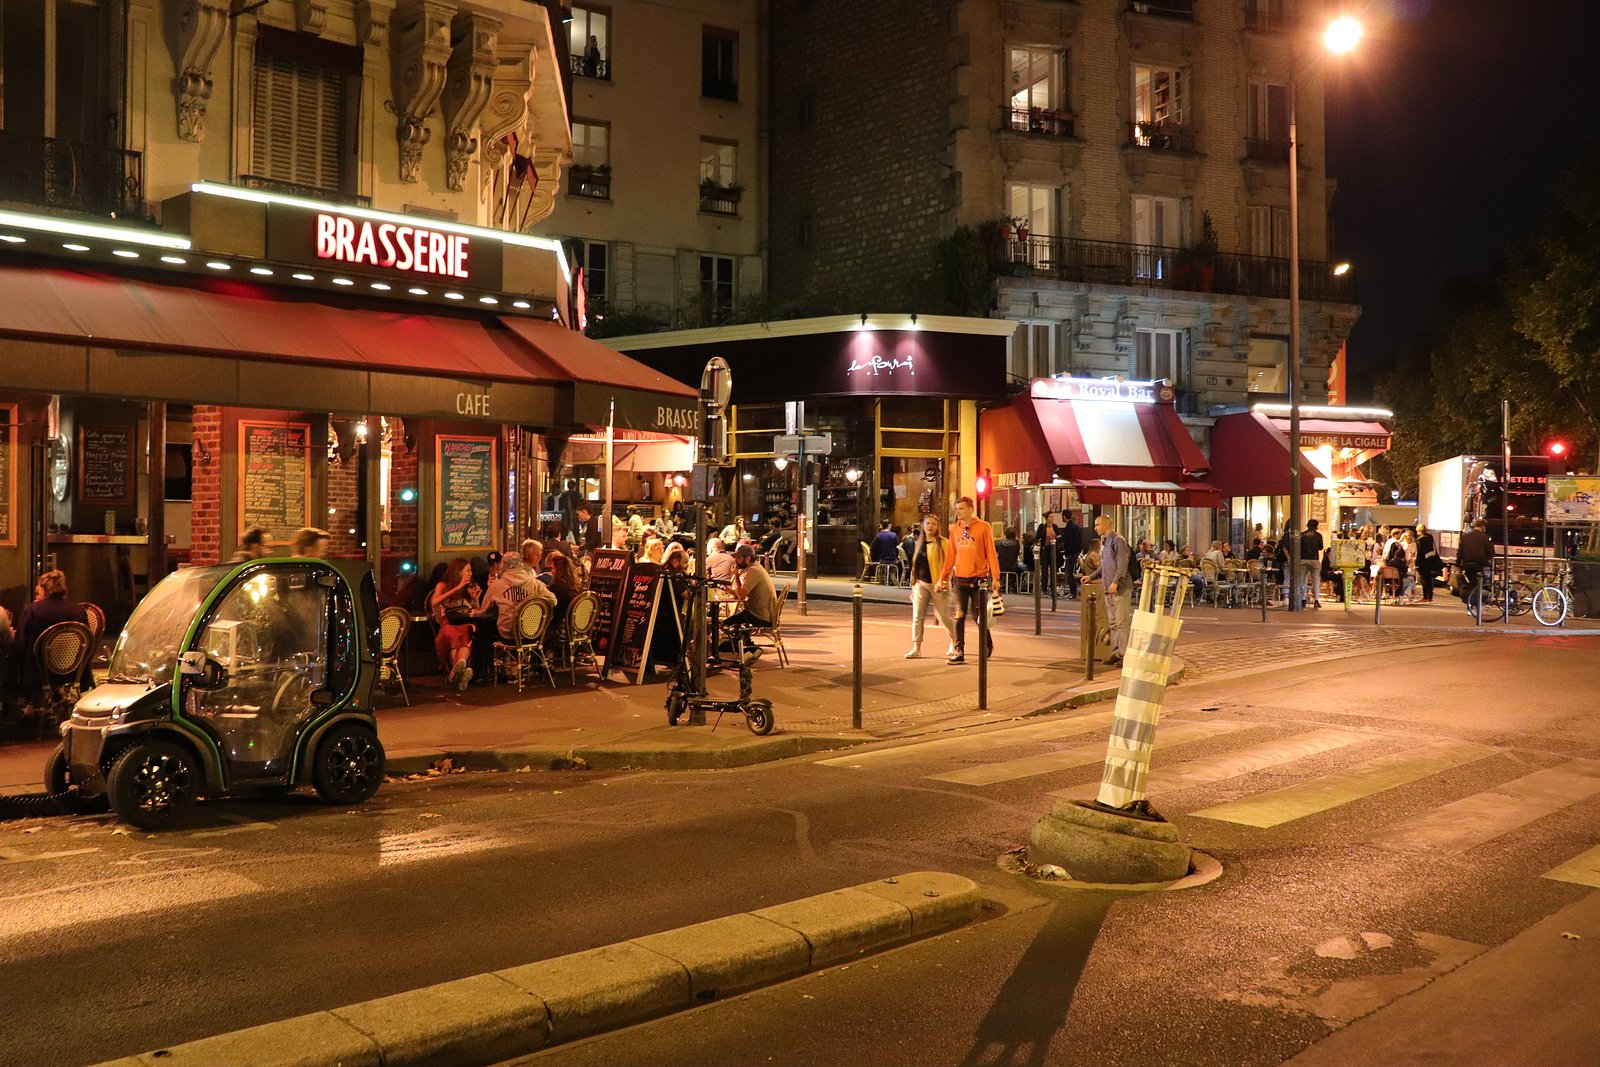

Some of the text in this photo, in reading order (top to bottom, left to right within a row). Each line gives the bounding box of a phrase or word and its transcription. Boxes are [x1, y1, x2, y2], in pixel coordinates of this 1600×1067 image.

[317, 214, 469, 278] BRASSERIE
[1078, 384, 1120, 398] Royal
[1128, 386, 1153, 399] Bar
[1326, 436, 1338, 445] DE
[1341, 437, 1352, 446] LA
[1355, 437, 1386, 447] CIGALE
[998, 471, 1029, 486] ROYAL BAR
[1121, 491, 1177, 507] ROYAL BAR
[632, 575, 654, 585] HAPPY
